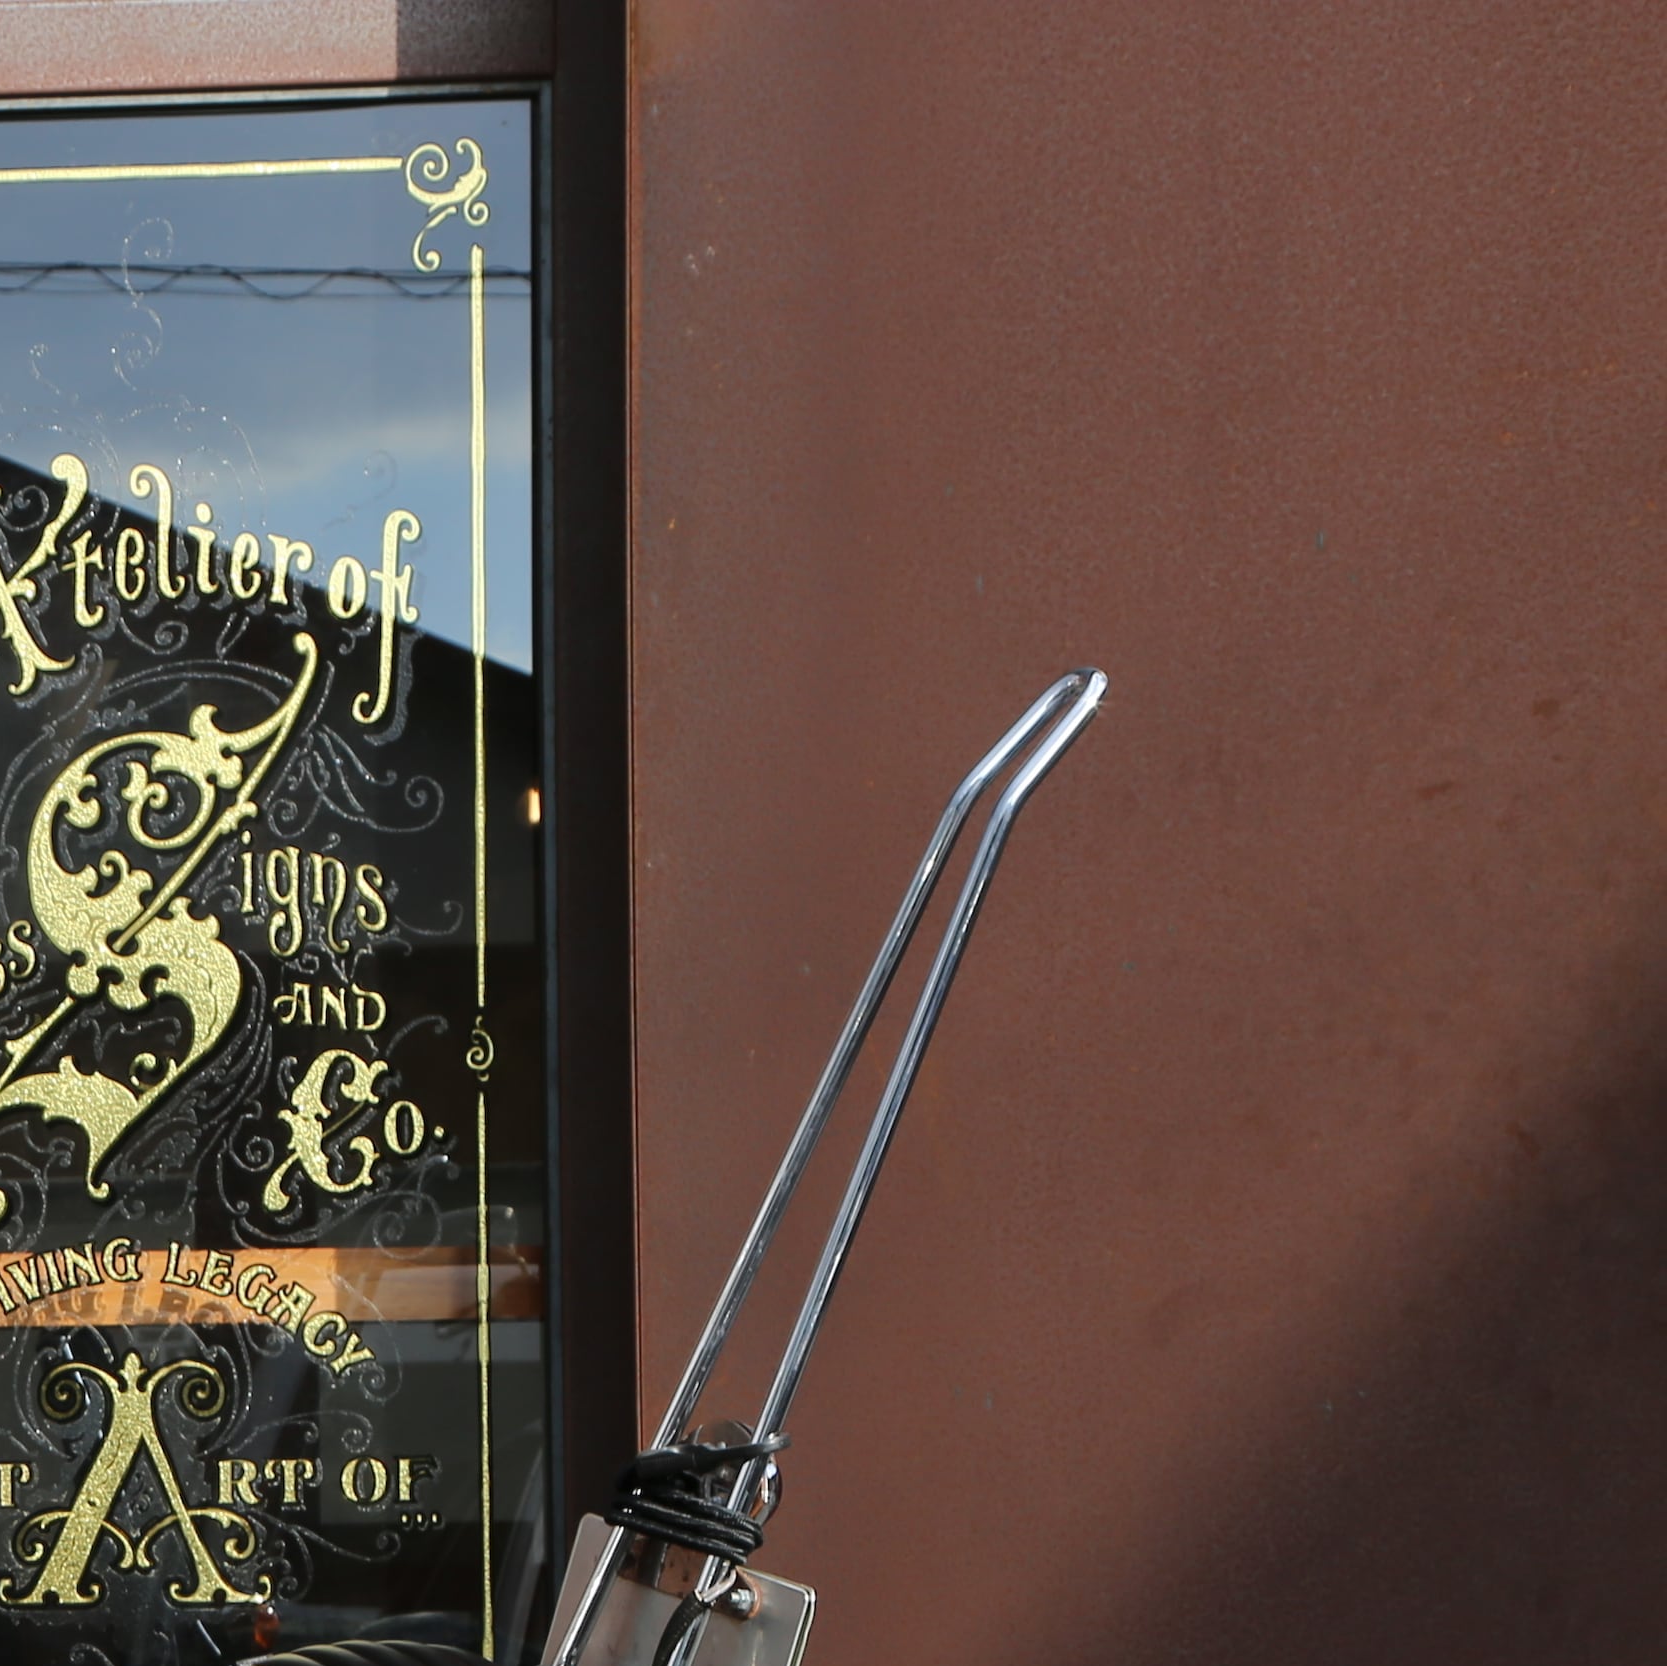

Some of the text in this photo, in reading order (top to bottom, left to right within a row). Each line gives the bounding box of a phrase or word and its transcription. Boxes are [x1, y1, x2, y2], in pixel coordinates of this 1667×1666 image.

[327, 509, 422, 725] of
[273, 982, 387, 1031] AND
[162, 1241, 375, 1374] LEGACY
